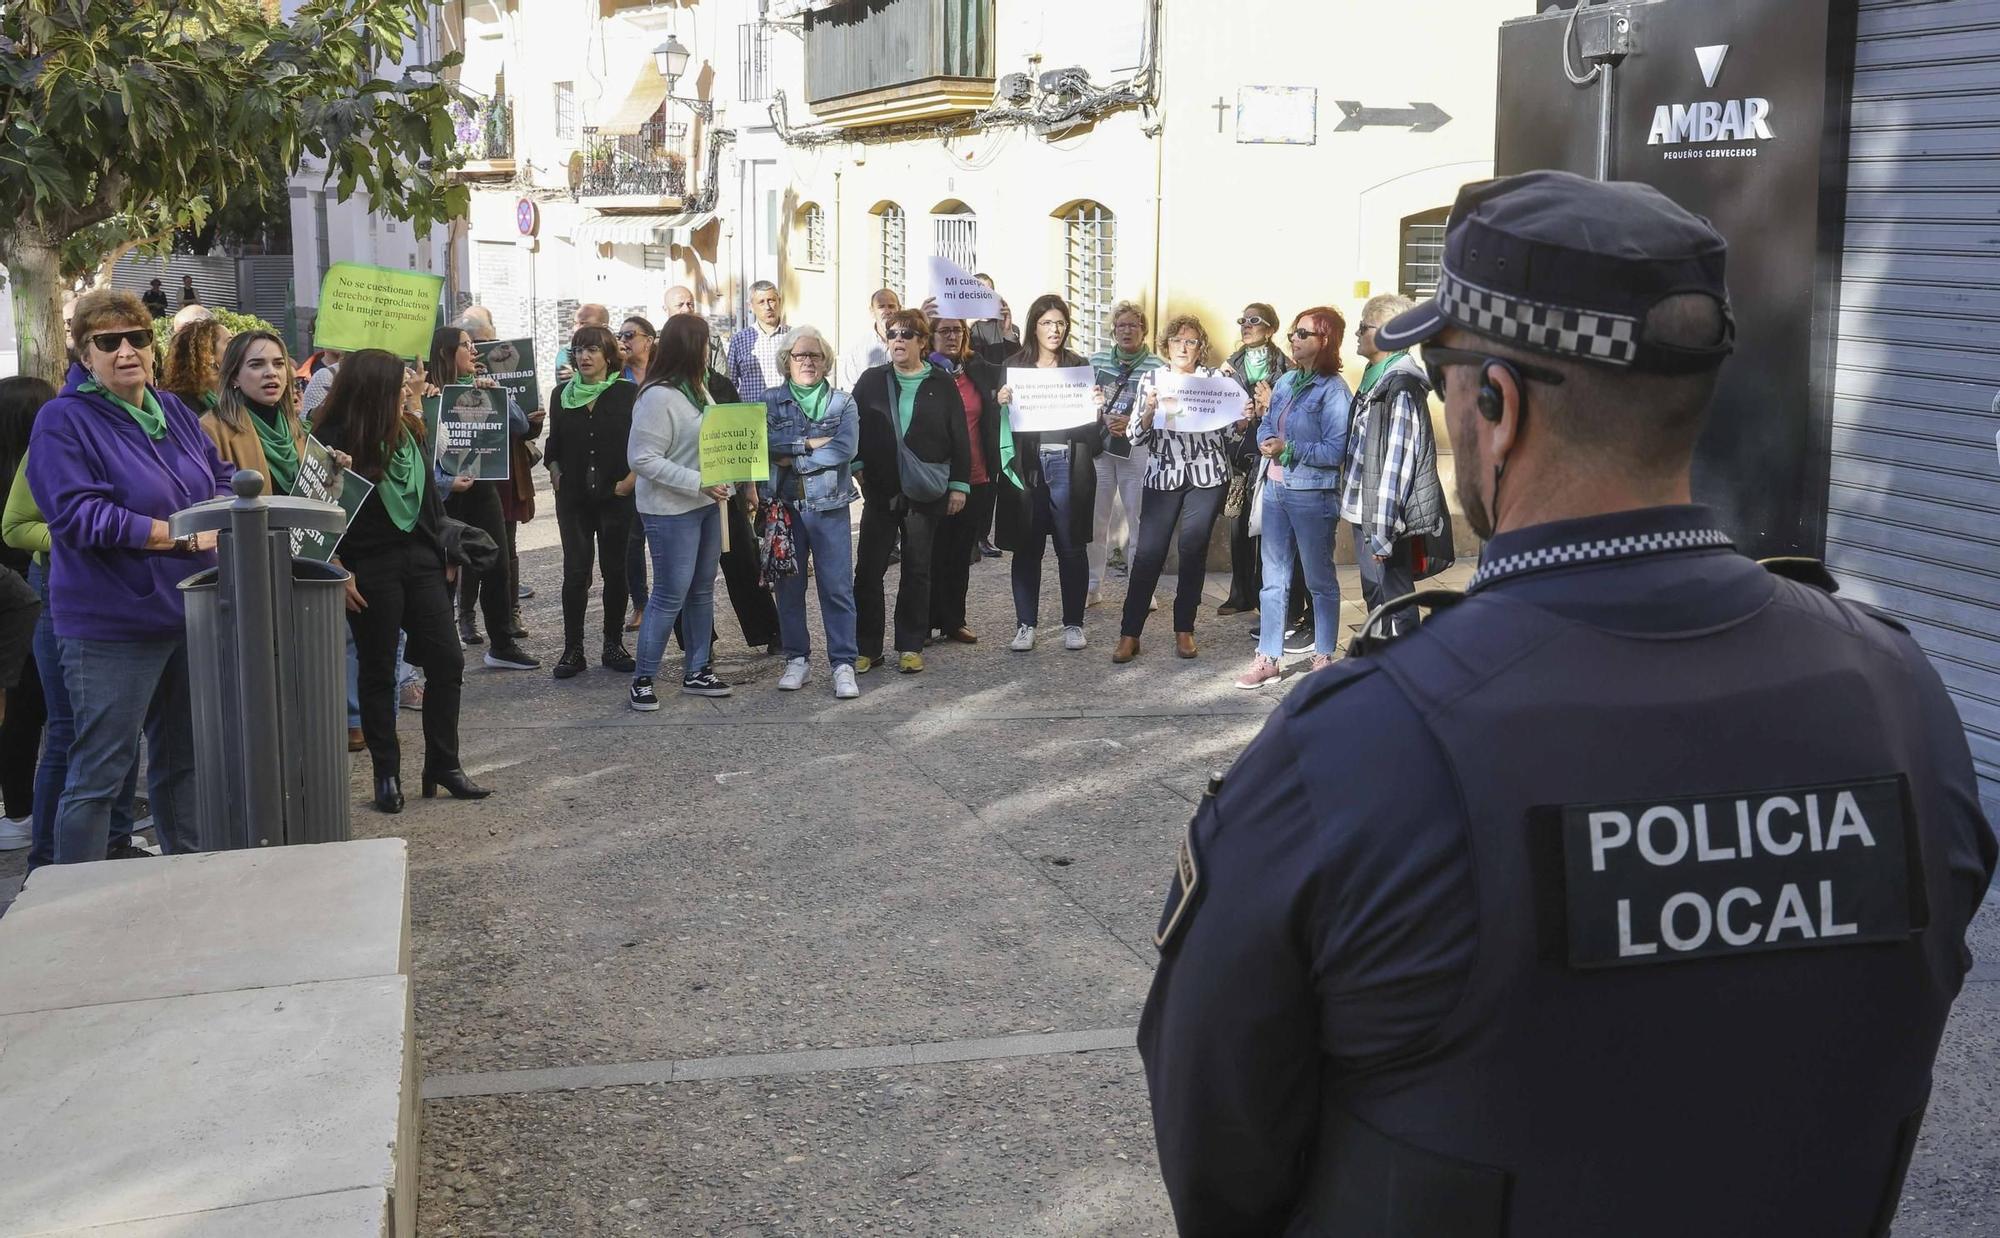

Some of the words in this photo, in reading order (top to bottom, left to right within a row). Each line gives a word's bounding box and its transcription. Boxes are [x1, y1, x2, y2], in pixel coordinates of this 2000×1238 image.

[1647, 98, 1776, 145] AMBAR
[1664, 149, 1703, 160] PEQUEÑOS
[1705, 148, 1757, 158] CERVECEROS
[339, 277, 353, 287] No
[355, 280, 365, 289] se
[367, 283, 413, 296] cuestionan
[417, 289, 429, 298] los
[945, 277, 957, 286] Mi
[959, 278, 985, 288] cuerp
[332, 289, 373, 302] derechos
[374, 296, 430, 310] reproductivos
[944, 291, 956, 299] mi
[958, 291, 993, 300] decisión
[332, 301, 344, 311] de
[346, 303, 354, 312] la
[356, 306, 382, 317] mujer
[384, 308, 427, 322] amparados
[364, 318, 380, 328] por
[382, 320, 398, 331] ley.
[1177, 389, 1222, 397] maternidad
[1199, 406, 1216, 414] será
[444, 422, 503, 430] AVORTAMENT
[722, 427, 747, 438] sexual
[750, 429, 756, 439] y
[736, 441, 747, 450] de
[750, 441, 759, 450] la
[727, 457, 736, 465] se
[738, 457, 761, 465] toca.
[306, 454, 318, 470] NO
[318, 464, 328, 483] LES
[302, 465, 328, 501] IMPORTA
[1588, 790, 1876, 872] POLICIA
[1617, 880, 1858, 957] LOCAL
